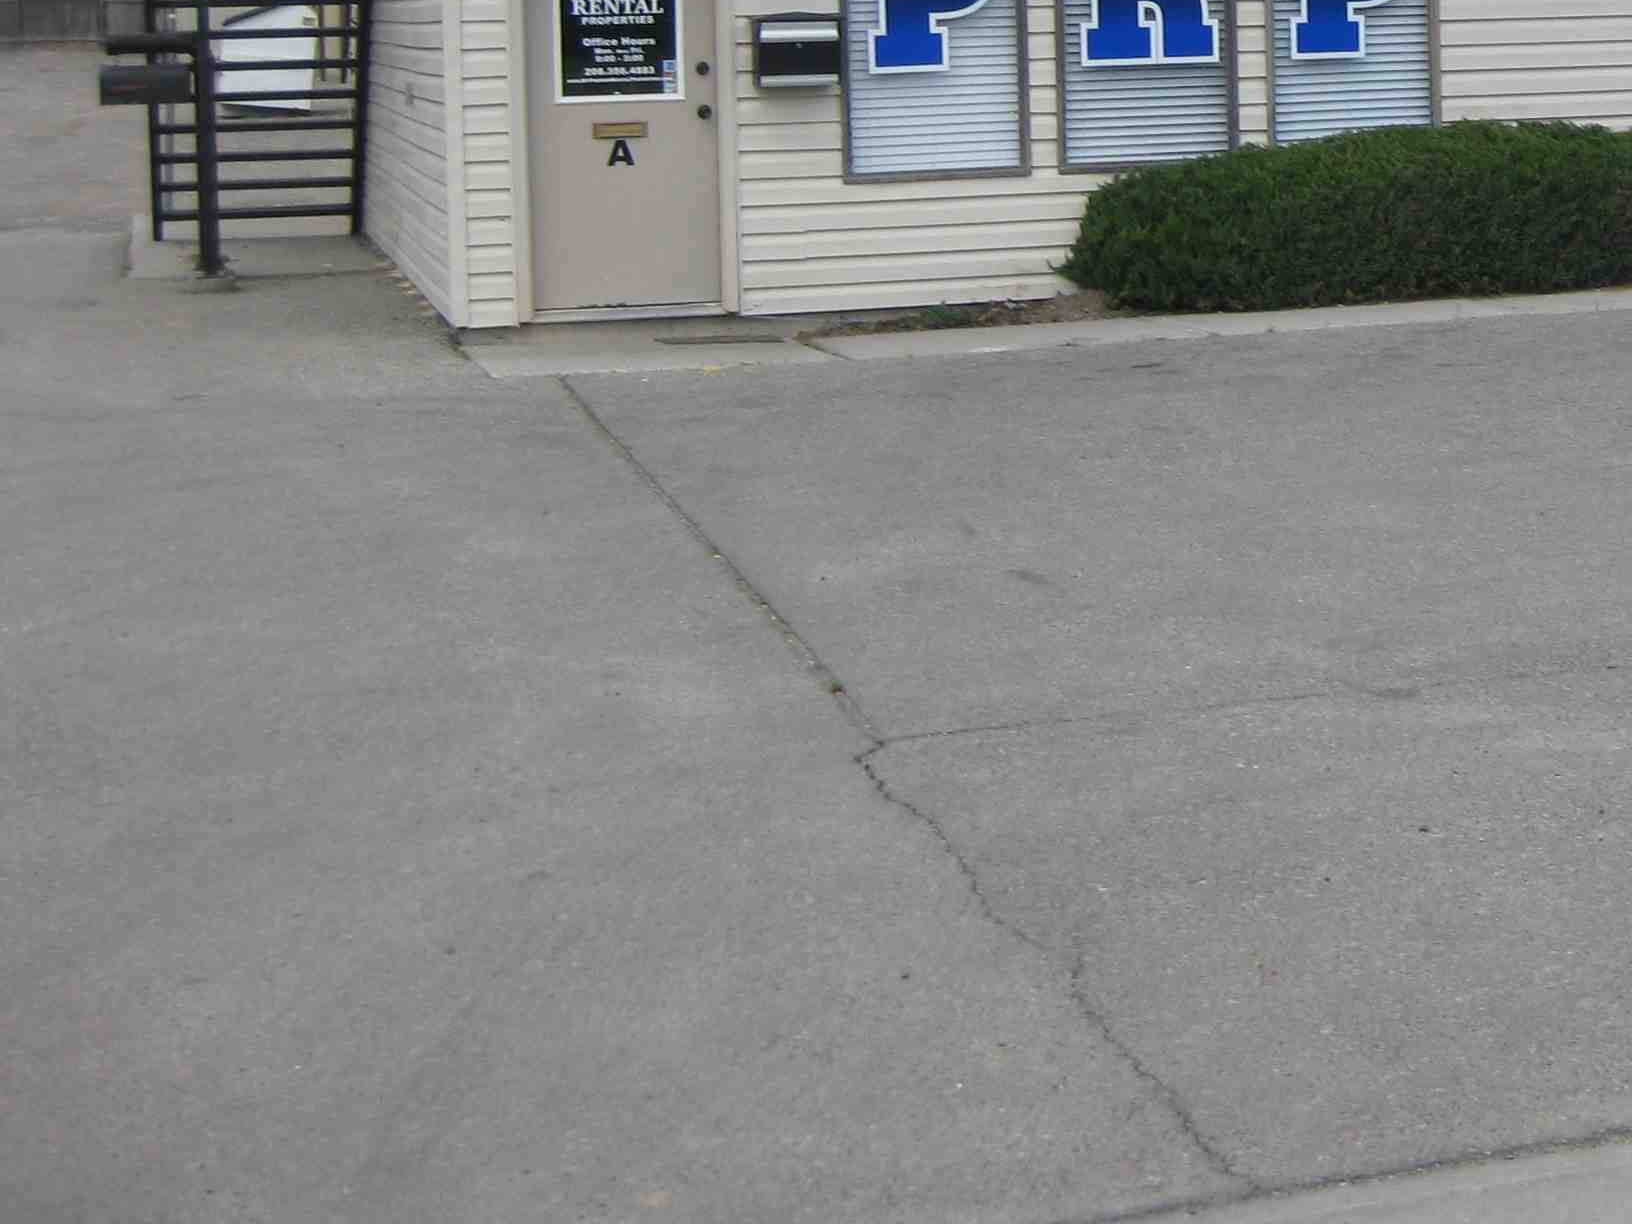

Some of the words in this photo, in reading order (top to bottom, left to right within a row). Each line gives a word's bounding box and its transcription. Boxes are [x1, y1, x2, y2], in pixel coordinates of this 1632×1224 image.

[581, 15, 656, 26] PROPERTIES
[582, 37, 618, 47] Office
[620, 36, 656, 46] Hours
[607, 139, 635, 167] A
